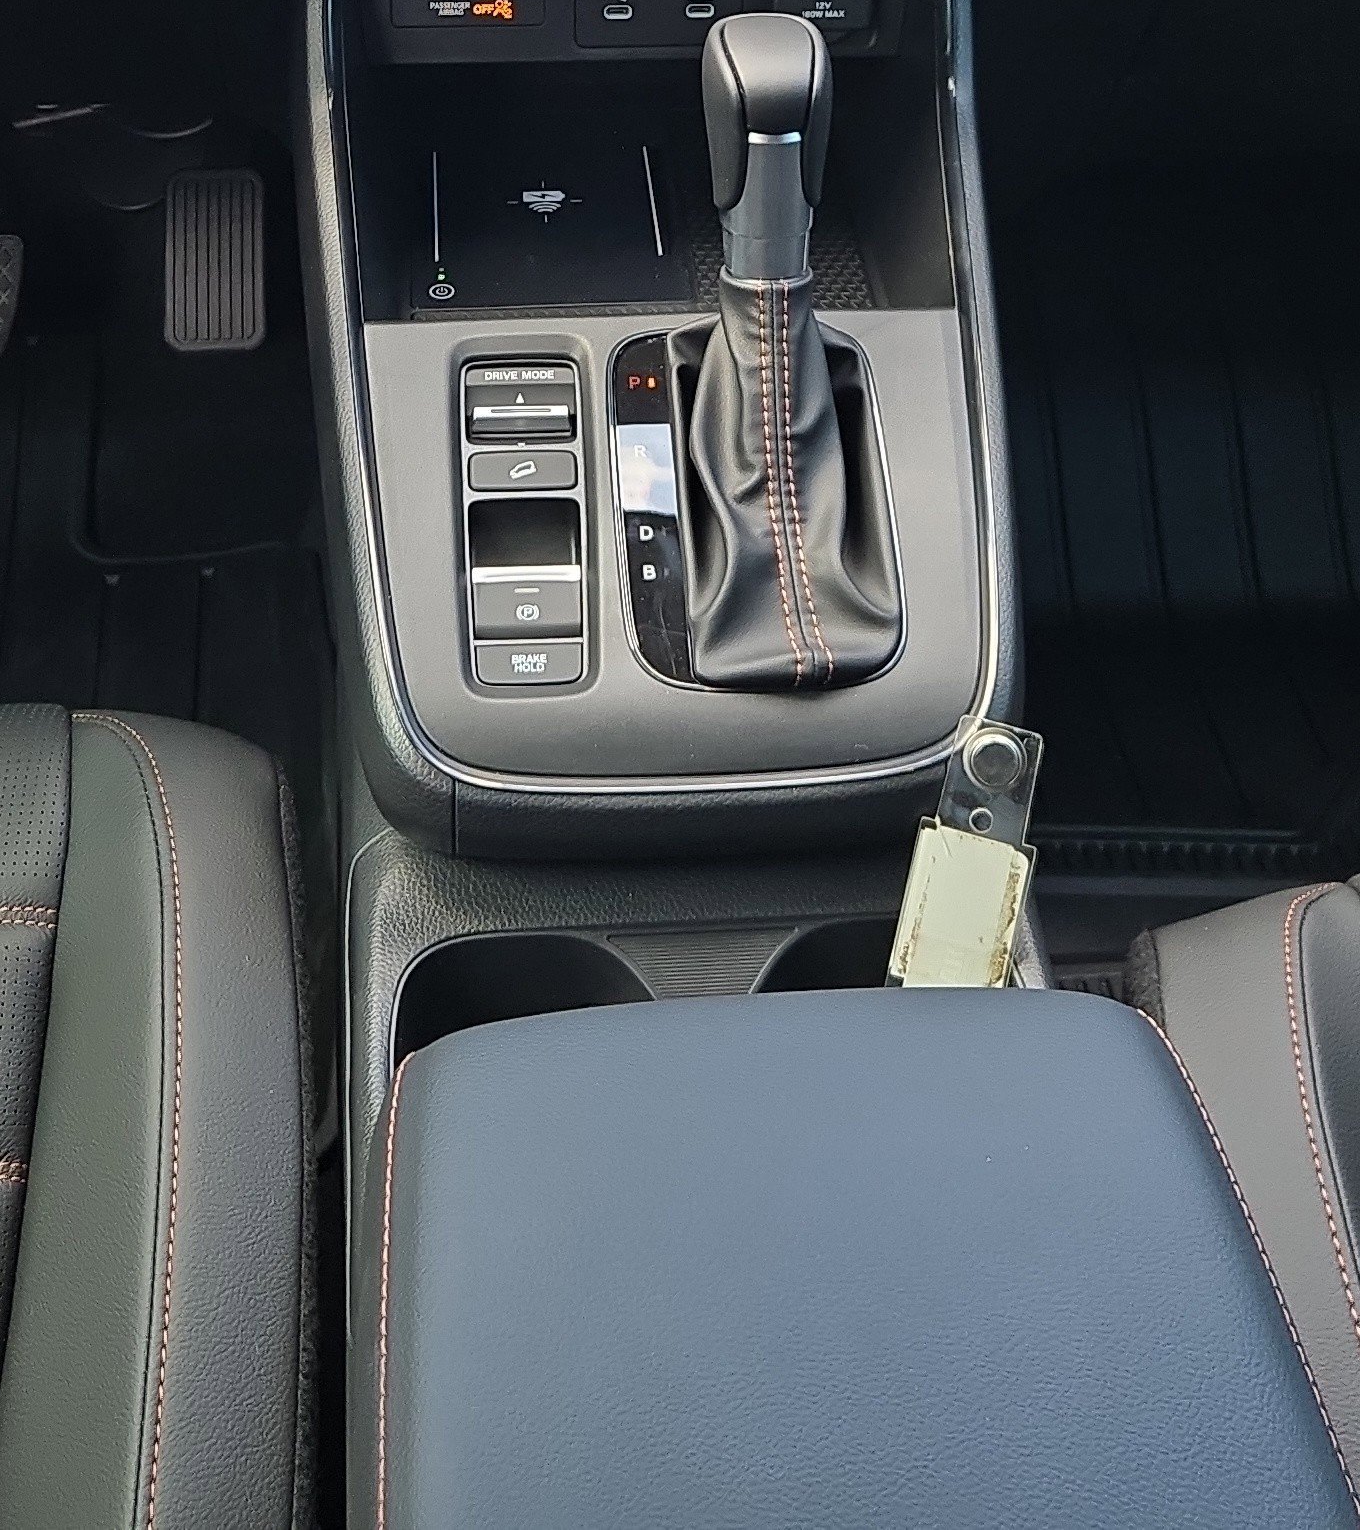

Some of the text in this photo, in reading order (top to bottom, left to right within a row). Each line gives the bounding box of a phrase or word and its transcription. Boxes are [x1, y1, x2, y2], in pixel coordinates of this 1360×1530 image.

[429, 1, 471, 10] PASSENGER
[472, 2, 495, 15] OFF
[815, 1, 833, 10] 12V
[437, 8, 465, 17] AIRBAG
[824, 10, 846, 19] MAX
[483, 369, 555, 381] DRIVE MODE
[628, 375, 641, 389] P
[634, 444, 647, 458] R
[639, 525, 654, 542] D
[642, 563, 657, 581] B
[511, 652, 548, 664] BRAKE
[513, 662, 546, 674] HOLD
